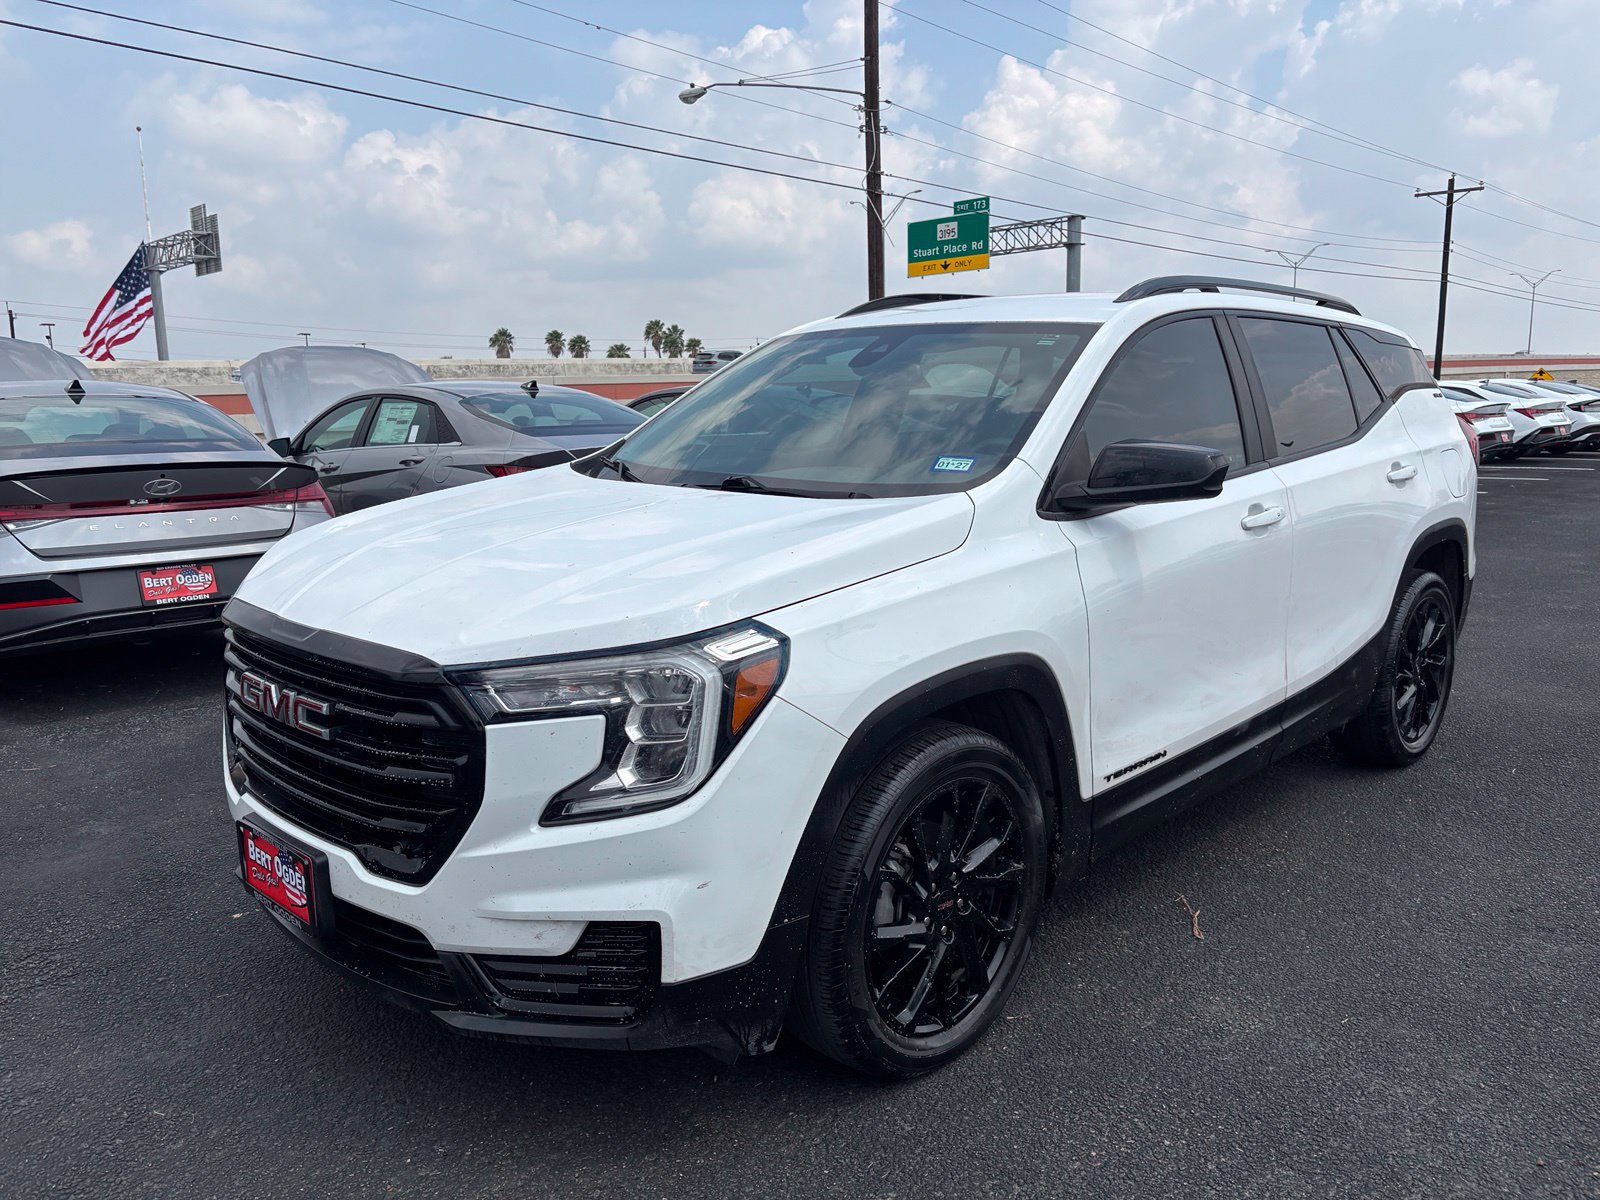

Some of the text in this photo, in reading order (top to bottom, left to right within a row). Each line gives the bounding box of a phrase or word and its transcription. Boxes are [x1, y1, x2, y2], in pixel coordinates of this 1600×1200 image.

[973, 200, 986, 210] 173
[938, 228, 956, 239] 3195
[913, 240, 983, 258] Stuart Place Rd
[954, 260, 972, 268] ONLY
[89, 514, 239, 531] ELANTRA
[143, 573, 212, 588] BERT OGDEN
[156, 594, 210, 605] BERT OGDEN
[240, 671, 330, 740] GMC
[247, 838, 272, 871] BERT
